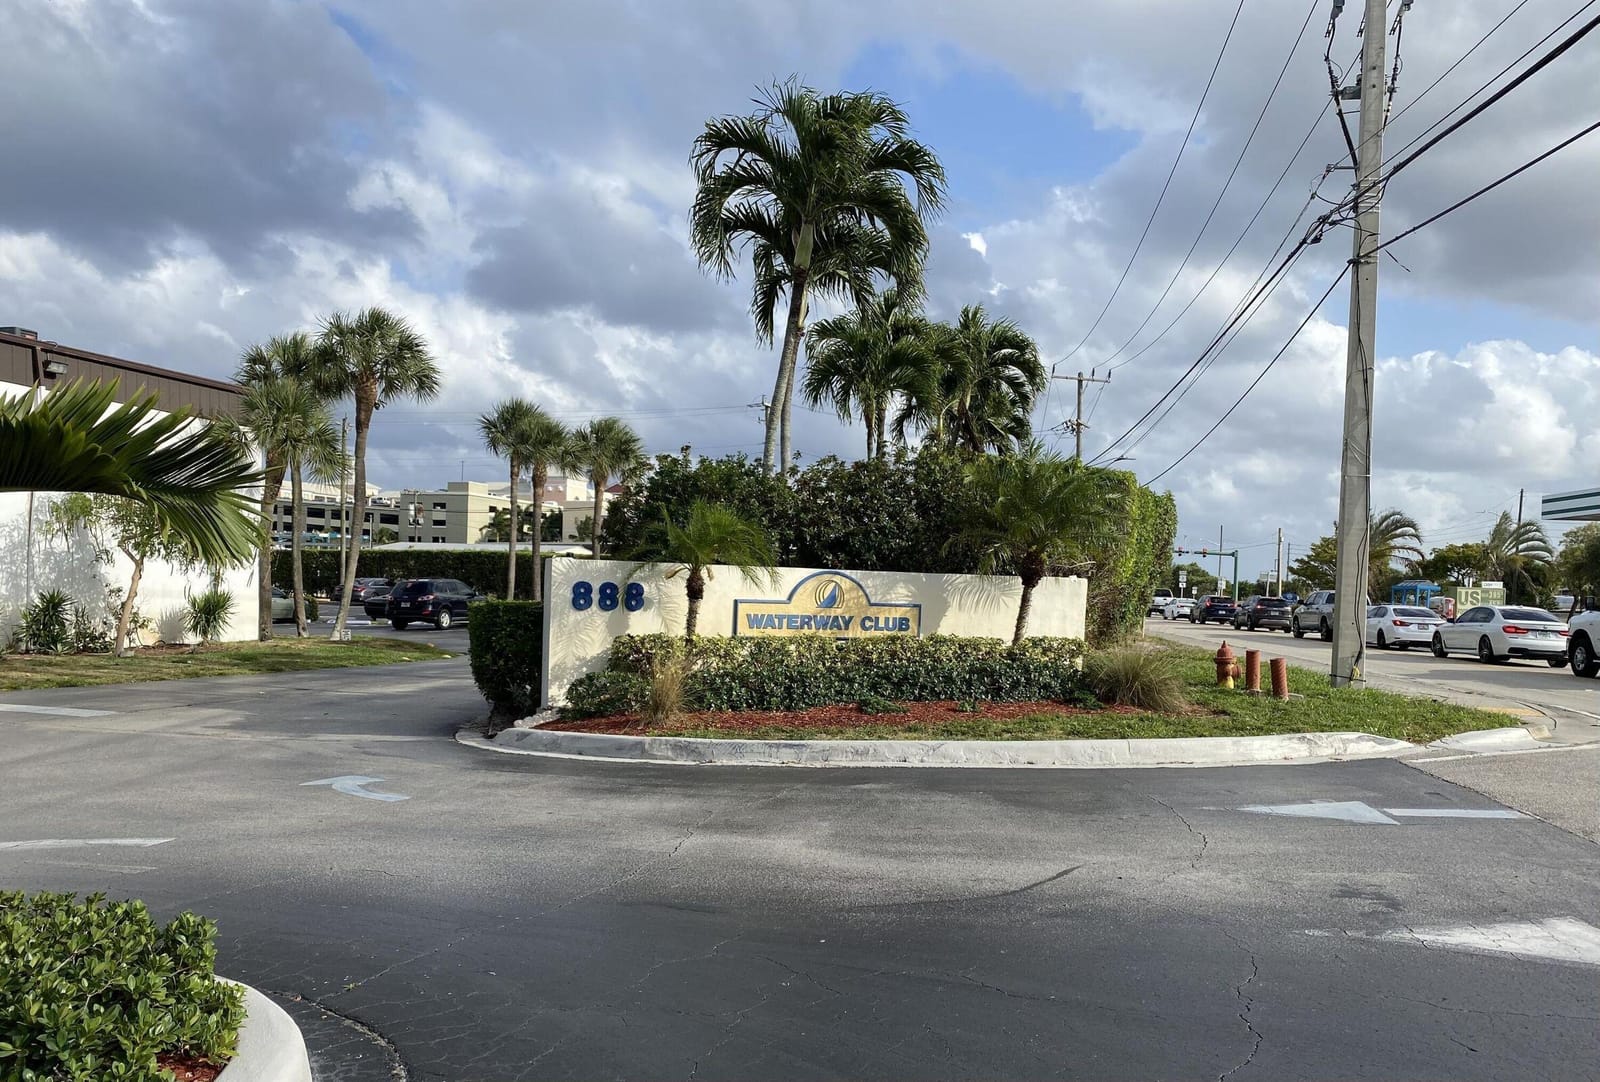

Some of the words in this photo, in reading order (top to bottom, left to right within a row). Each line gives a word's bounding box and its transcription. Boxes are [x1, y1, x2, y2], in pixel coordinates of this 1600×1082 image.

[572, 581, 645, 611] 888
[1458, 590, 1480, 606] US
[746, 614, 854, 630] WATERWAY
[860, 615, 910, 631] CLUB
